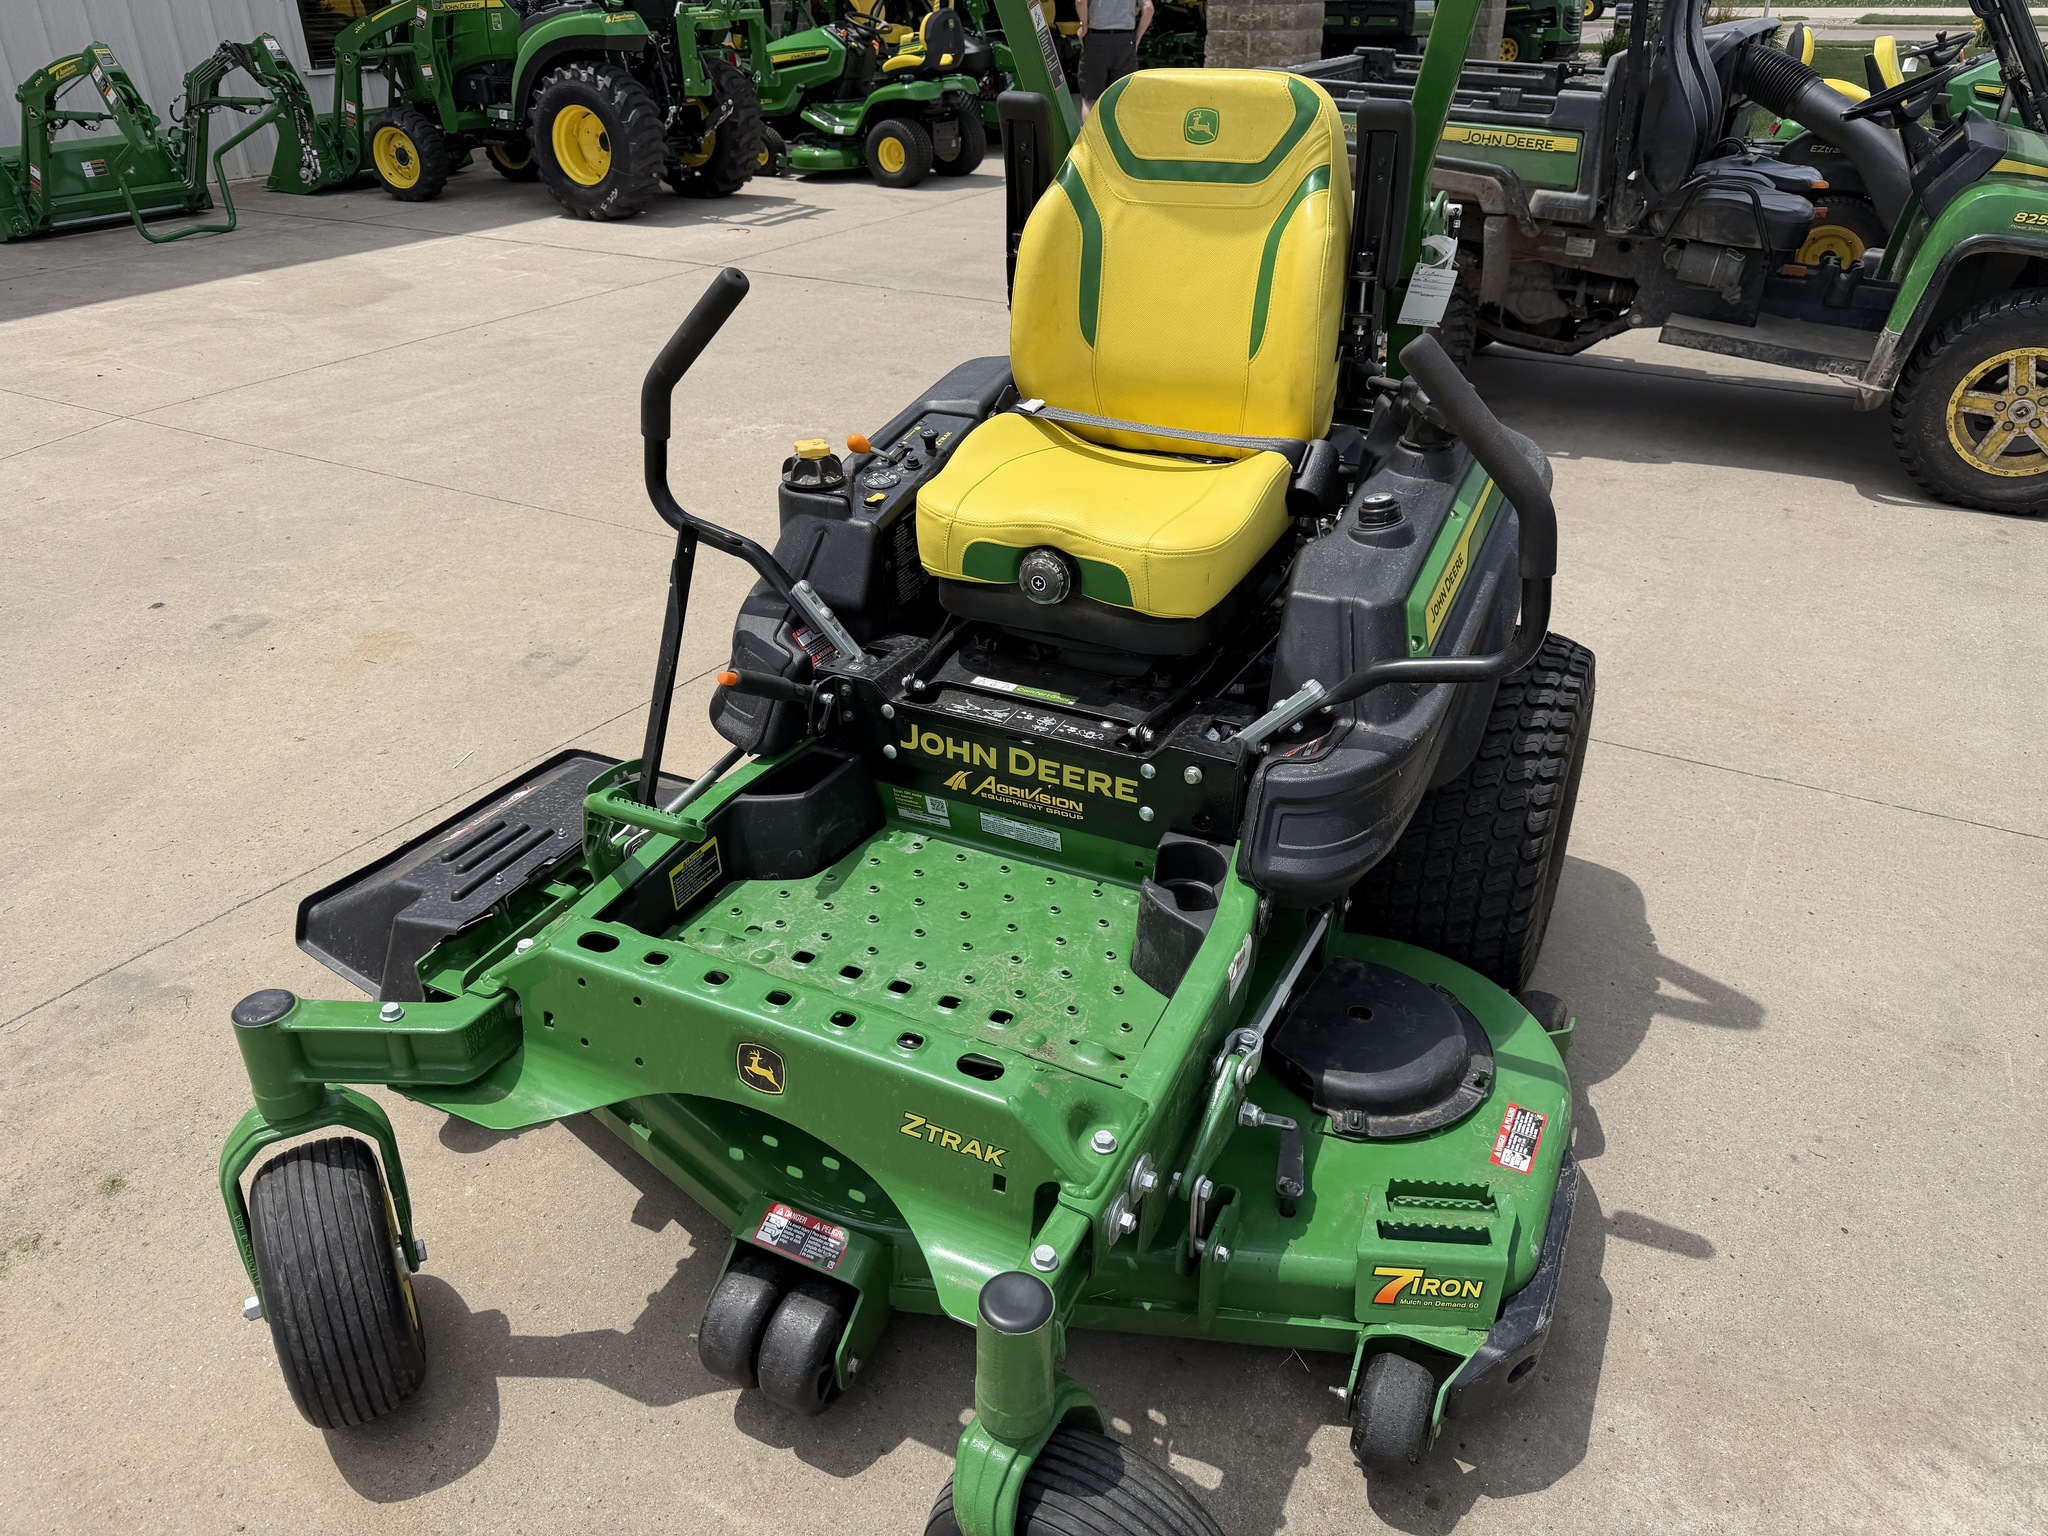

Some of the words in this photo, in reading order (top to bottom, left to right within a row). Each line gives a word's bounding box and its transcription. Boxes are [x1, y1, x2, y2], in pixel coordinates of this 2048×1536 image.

[1462, 130, 1503, 146] JOHN
[1504, 134, 1555, 150] DEERE
[1809, 144, 1841, 154] EZtra
[2013, 211, 2048, 226] 825
[1431, 590, 1449, 624] JOHN
[1444, 552, 1465, 594] DEERE
[900, 724, 997, 769] JOHN
[1008, 747, 1139, 803] DEERE
[981, 791, 1044, 811] EQUIPMENT
[1045, 807, 1084, 821] GROUP
[900, 1111, 1009, 1169] ZTRAK
[784, 1209, 808, 1224] DANGER
[1411, 1277, 1483, 1298] IRON
[1435, 1300, 1466, 1308] Demand
